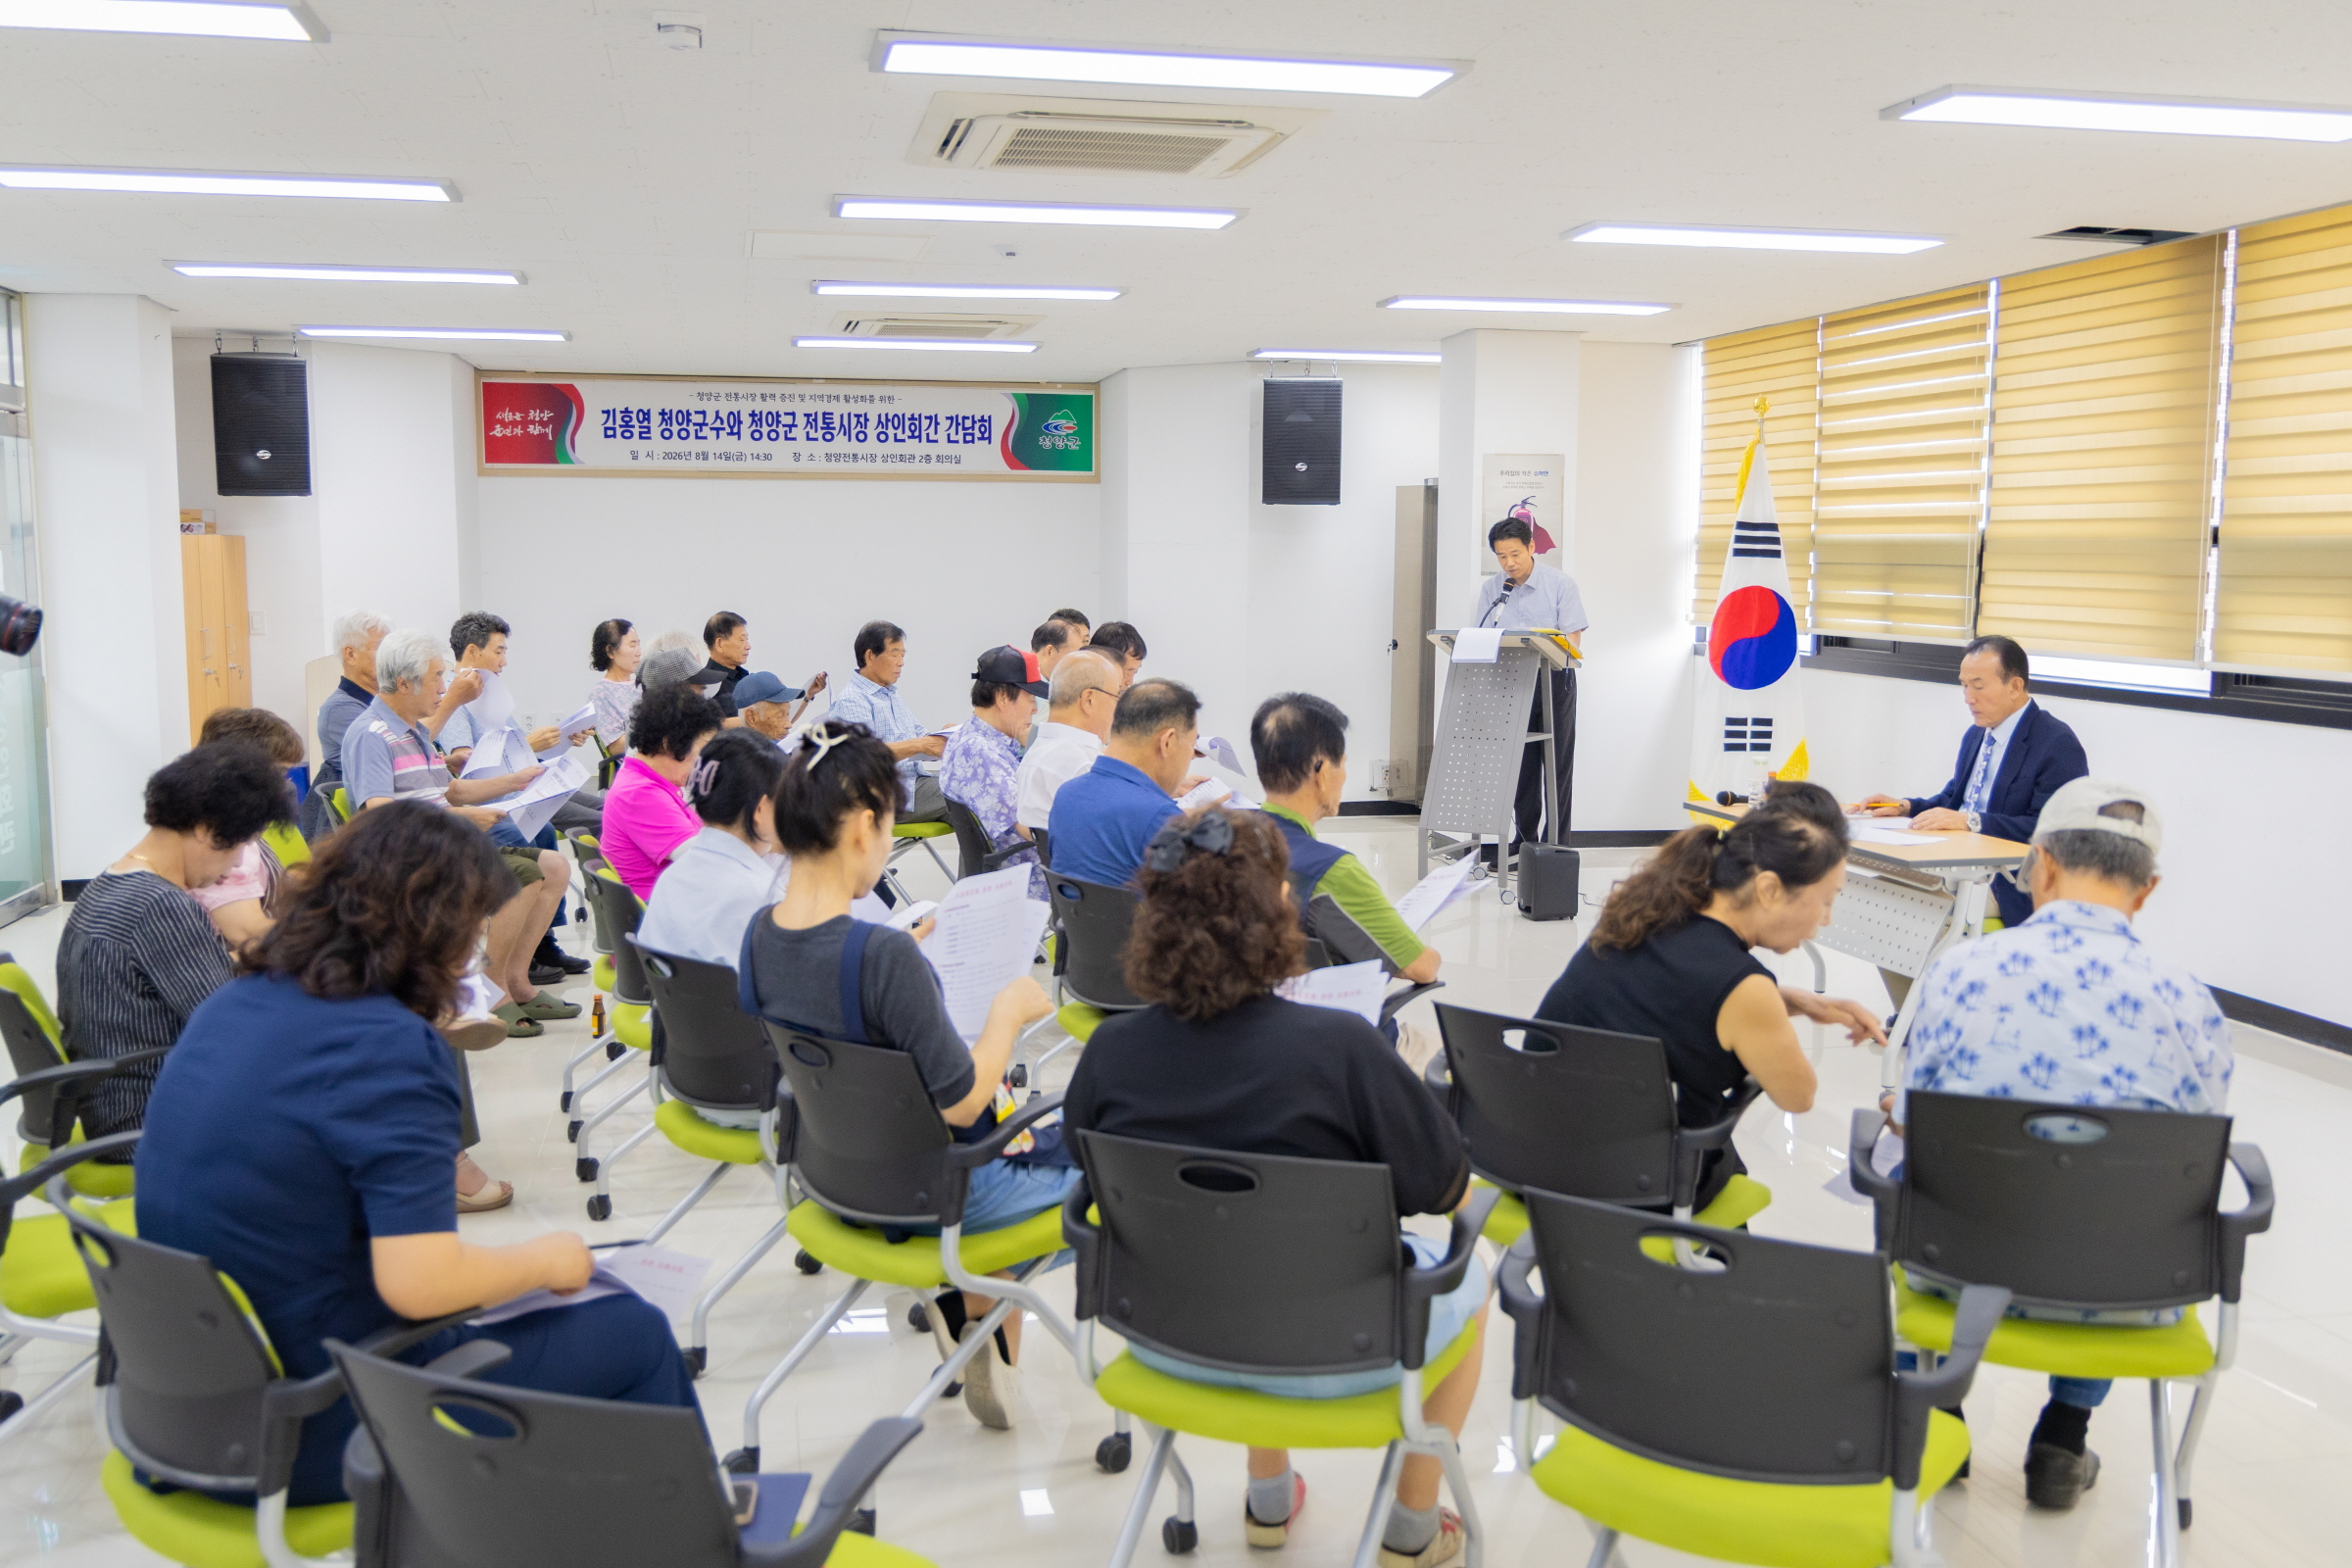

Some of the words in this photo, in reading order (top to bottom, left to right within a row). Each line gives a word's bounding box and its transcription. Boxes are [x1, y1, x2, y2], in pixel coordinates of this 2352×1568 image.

[696, 391, 722, 402] 청양군
[723, 391, 758, 403] 전통시장
[759, 392, 776, 403] 활력
[778, 392, 796, 403] 증진
[798, 392, 807, 404] 및
[808, 393, 841, 404] 지역경제
[842, 393, 877, 405] 활성화를
[877, 394, 896, 405] 위한
[496, 408, 524, 422] 새로운
[527, 409, 555, 421] 청양
[601, 407, 652, 440] 김홍열
[658, 408, 743, 441] 청양군수와
[748, 410, 798, 442] 청양군
[803, 411, 869, 443] 전통시장
[874, 413, 940, 443] 상인회간
[945, 414, 992, 445] 간담회
[1039, 435, 1081, 450] 청양군
[629, 449, 639, 461] 일
[662, 450, 692, 462] 2026년
[694, 450, 710, 462] 8월
[711, 451, 748, 463] 14일(금)
[750, 452, 773, 462] 14:30
[792, 451, 803, 463] 장
[823, 452, 878, 464] 청양전통시장
[880, 453, 917, 465] 상인회관
[918, 453, 933, 465] 2층
[934, 453, 961, 466] 회의실
